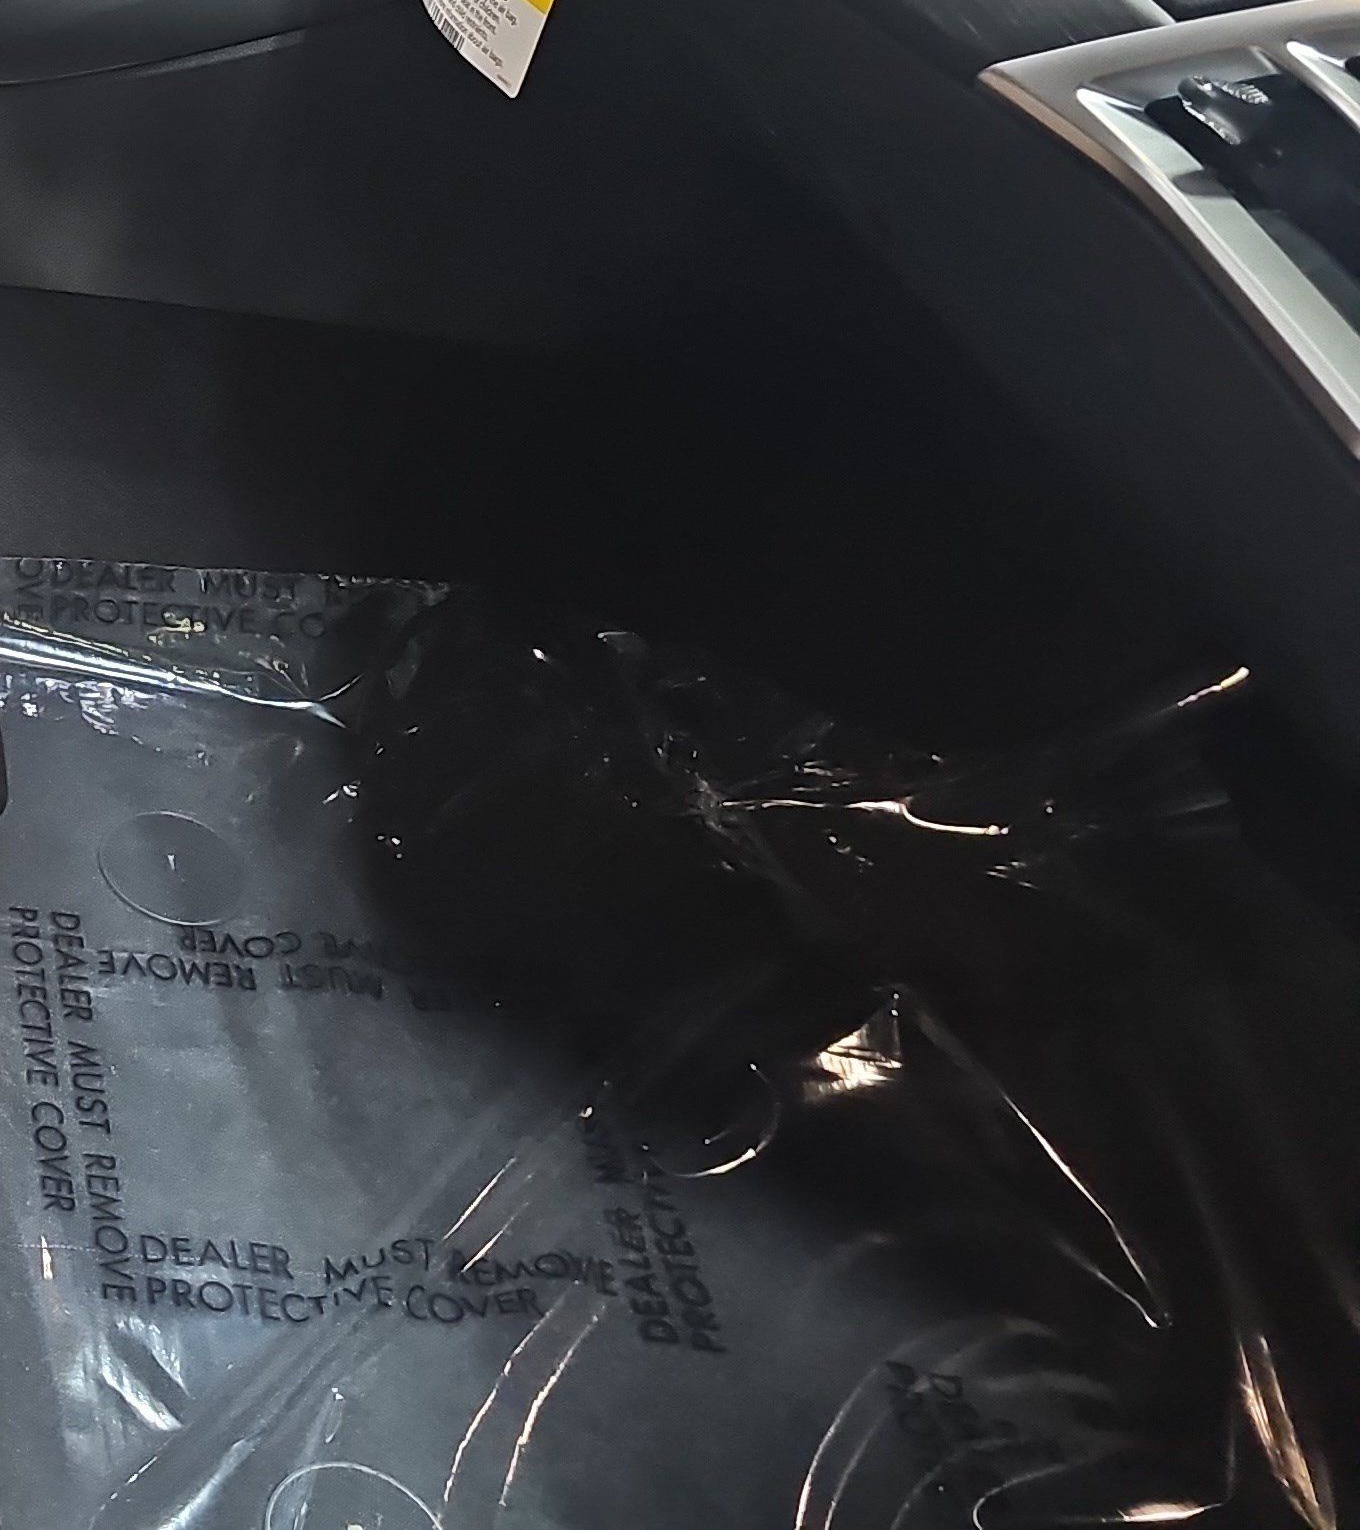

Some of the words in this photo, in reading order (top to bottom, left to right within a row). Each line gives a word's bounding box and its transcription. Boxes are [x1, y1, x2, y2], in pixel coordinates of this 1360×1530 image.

[49, 557, 177, 594] DEALER
[49, 910, 94, 1022] DEALER
[97, 949, 258, 992] REMOVE
[180, 927, 302, 960] COVER
[8, 905, 60, 1087] PROTECTIVE
[66, 1040, 112, 1135] MUST
[27, 1100, 76, 1213] COVER
[80, 1152, 137, 1305] REMOVE
[139, 1233, 293, 1280] DEALER
[323, 1238, 436, 1285] MUST
[602, 1206, 681, 1345] DEALER
[146, 1276, 394, 1325] PROTECTIVE
[406, 1283, 547, 1325] COVER
